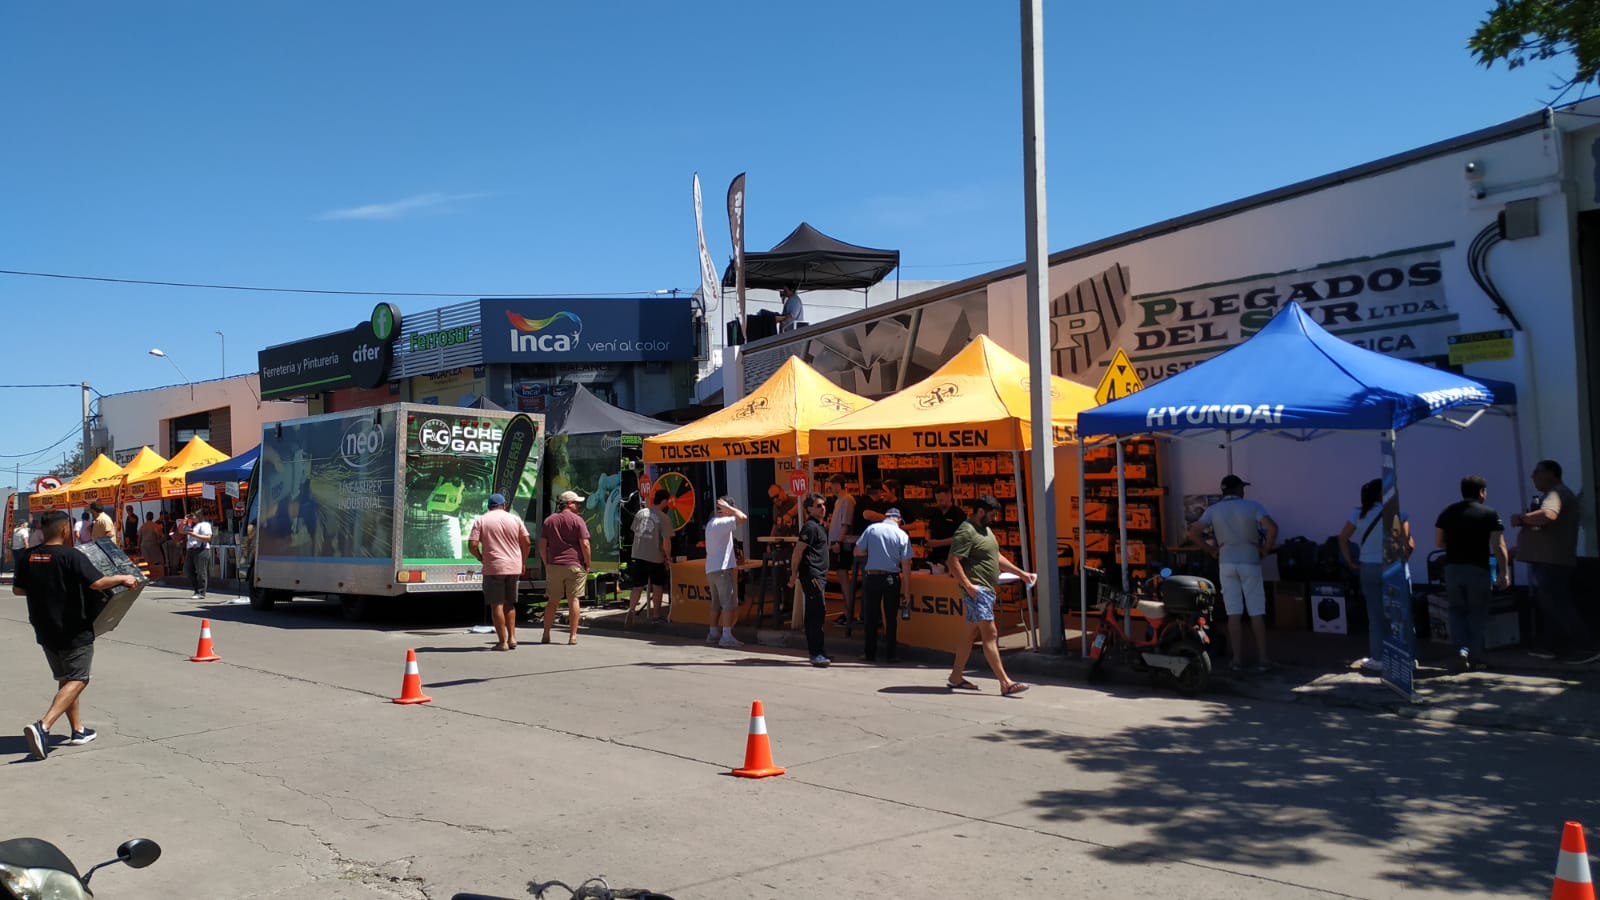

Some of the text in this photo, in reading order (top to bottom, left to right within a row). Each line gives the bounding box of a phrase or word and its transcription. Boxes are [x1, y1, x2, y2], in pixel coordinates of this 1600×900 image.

[1137, 260, 1443, 328] PLEGADOS
[408, 325, 474, 353] Ferrosur
[510, 328, 571, 352] Inca
[619, 339, 633, 352] al
[635, 339, 670, 352] color
[1134, 322, 1229, 351] DEL
[352, 343, 380, 363] cifer
[296, 361, 303, 376] y
[1146, 404, 1285, 427] HYUNDAI
[346, 429, 379, 456] neo
[422, 428, 449, 445] F&G
[827, 432, 892, 452] TOLSEN
[912, 429, 989, 448] TOLSEN
[660, 438, 781, 459] TOLSEN TOLSEN
[792, 477, 808, 493] IVA
